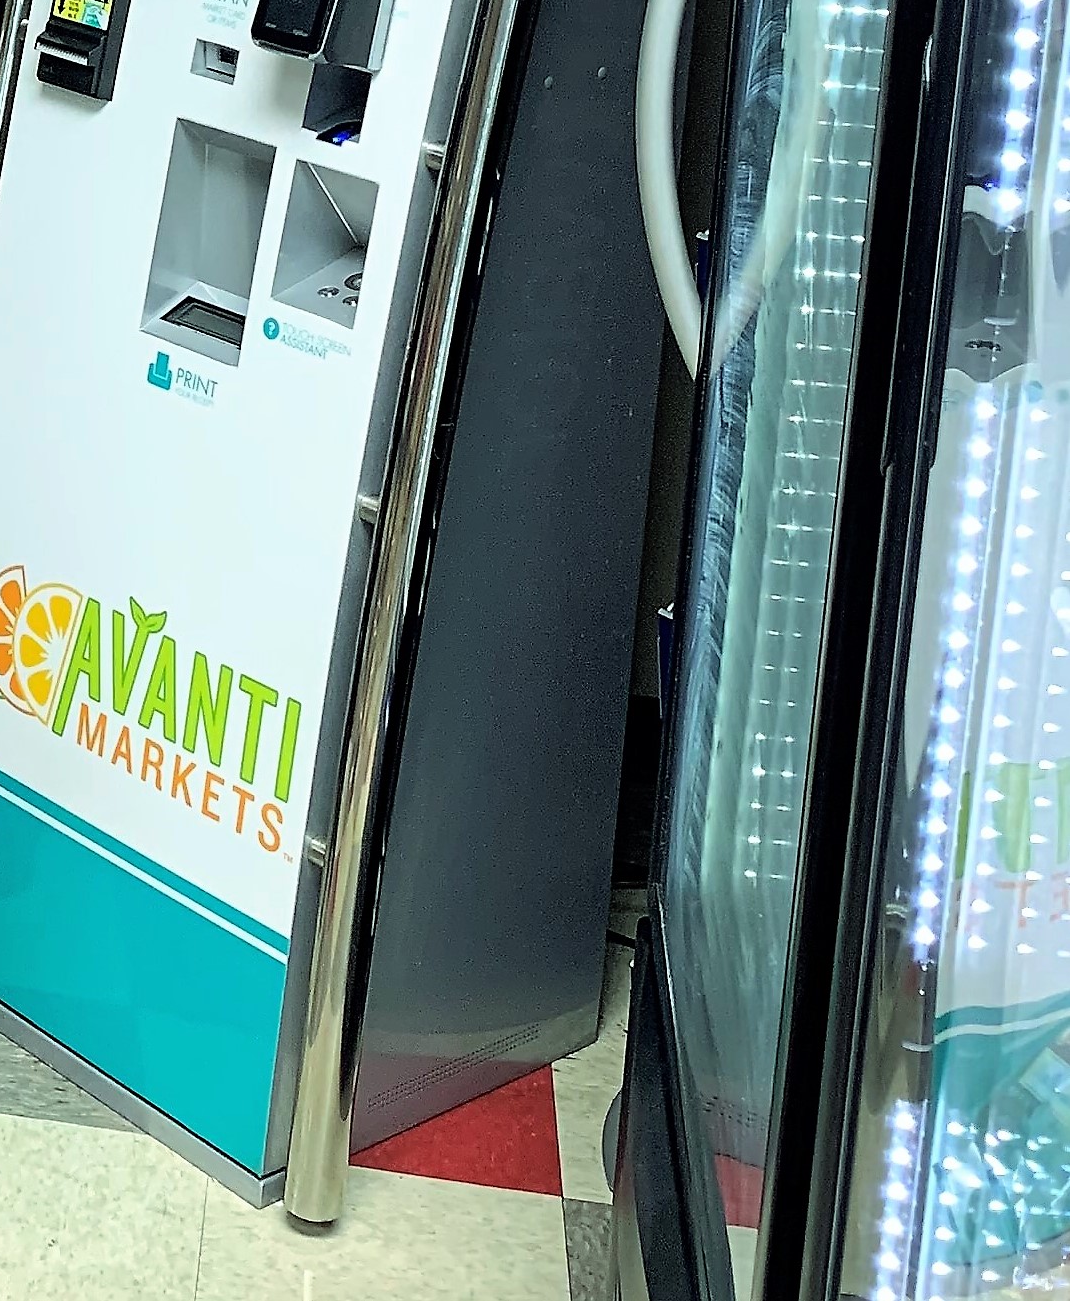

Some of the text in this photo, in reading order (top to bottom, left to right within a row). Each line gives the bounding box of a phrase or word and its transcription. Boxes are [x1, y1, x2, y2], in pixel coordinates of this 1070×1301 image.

[176, 367, 218, 398] PRINT
[51, 595, 302, 804] AVANTI
[76, 702, 284, 853] MARKETS
